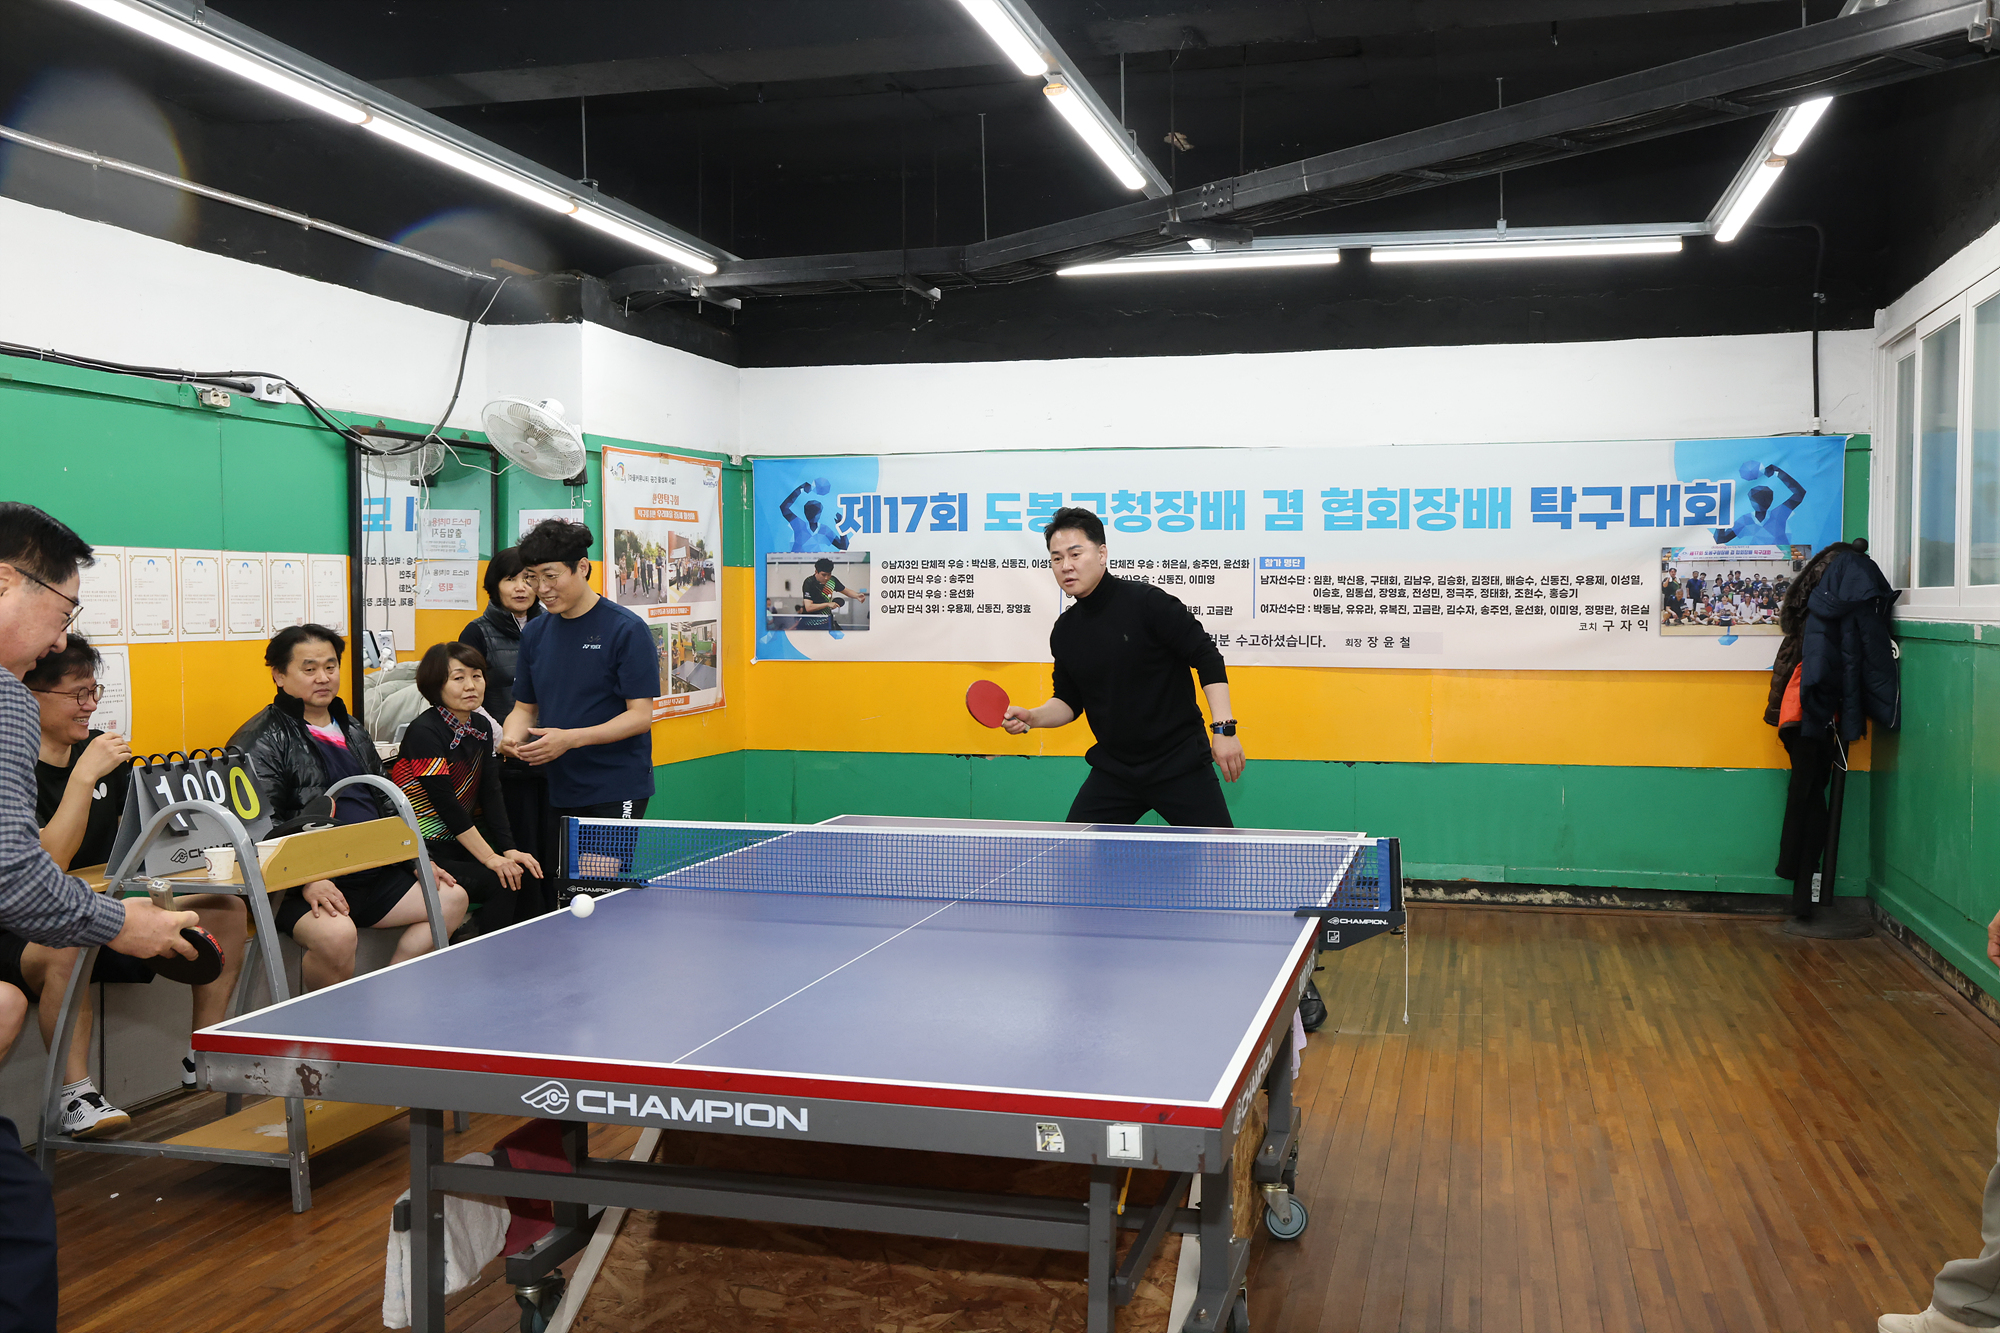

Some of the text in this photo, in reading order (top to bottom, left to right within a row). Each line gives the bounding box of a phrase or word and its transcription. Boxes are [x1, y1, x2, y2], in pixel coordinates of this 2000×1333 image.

[840, 492, 968, 534] 제17회
[1263, 489, 1304, 531] 겸
[1320, 487, 1511, 531] 협회장배
[1530, 482, 1732, 530] 탁구대회
[948, 560, 964, 569] 우승
[972, 559, 999, 569] 박신용,
[1002, 559, 1029, 569] 신동진,
[1110, 560, 1135, 569] 단체전
[1137, 560, 1154, 569] 우승
[1162, 560, 1190, 570] 허은실,
[1192, 560, 1221, 570] 송주연,
[1224, 559, 1250, 569] 윤선화
[1264, 558, 1300, 568] 참가 명단
[889, 575, 906, 584] 여자
[907, 575, 924, 584] 단식
[926, 575, 942, 584] 우승
[949, 574, 974, 584] 송주연
[1158, 574, 1186, 585] 신동진,
[1189, 574, 1215, 584] 이미영
[1260, 575, 1306, 585] 남자선수단
[1314, 576, 1334, 586] 임환,
[1337, 576, 1368, 586] 박신용,
[1370, 576, 1400, 586] 구태회,
[1404, 576, 1434, 586] 김남우,
[1438, 576, 1468, 586] 김승화,
[1472, 576, 1502, 586] 김정태,
[1506, 576, 1537, 586] 배승수,
[1540, 575, 1572, 586] 신동진,
[1575, 575, 1608, 586] 우용제,
[1610, 575, 1644, 586] 이성열,
[889, 590, 906, 599] 여자
[907, 590, 924, 598] 단식
[926, 590, 942, 598] 우승
[949, 588, 974, 598] 윤선화
[1313, 588, 1578, 599] 이승호, 임동섭, 장영효, 전성민, 정극주, 정태화, 조현수, 홍승기
[888, 604, 905, 614] 남자
[906, 604, 923, 614] 단식
[926, 604, 940, 614] 3위
[947, 604, 974, 614] 우용제,
[976, 604, 1004, 614] 신동진,
[1006, 604, 1032, 614] 장영효
[1206, 606, 1233, 616] 고금란
[1260, 604, 1306, 614] 여자선수단
[1314, 604, 1343, 614] 박동남,
[1346, 604, 1376, 614] 유유라,
[1380, 604, 1410, 615] 유복진,
[1412, 604, 1443, 615] 고금란,
[1446, 604, 1478, 615] 김수자,
[1480, 605, 1512, 616] 송주연,
[1514, 605, 1546, 616] 윤선화,
[1550, 605, 1581, 616] 이미영,
[1584, 605, 1617, 616] 정명란,
[1620, 604, 1650, 615] 허은실
[1579, 622, 1597, 632] 코치
[1236, 634, 1326, 648] 수고하셨습니다.
[1346, 638, 1362, 648] 회장
[1241, 1038, 1273, 1118] CHAMPION
[577, 1089, 808, 1132] CHAMPION
[1119, 1132, 1129, 1152] 1
